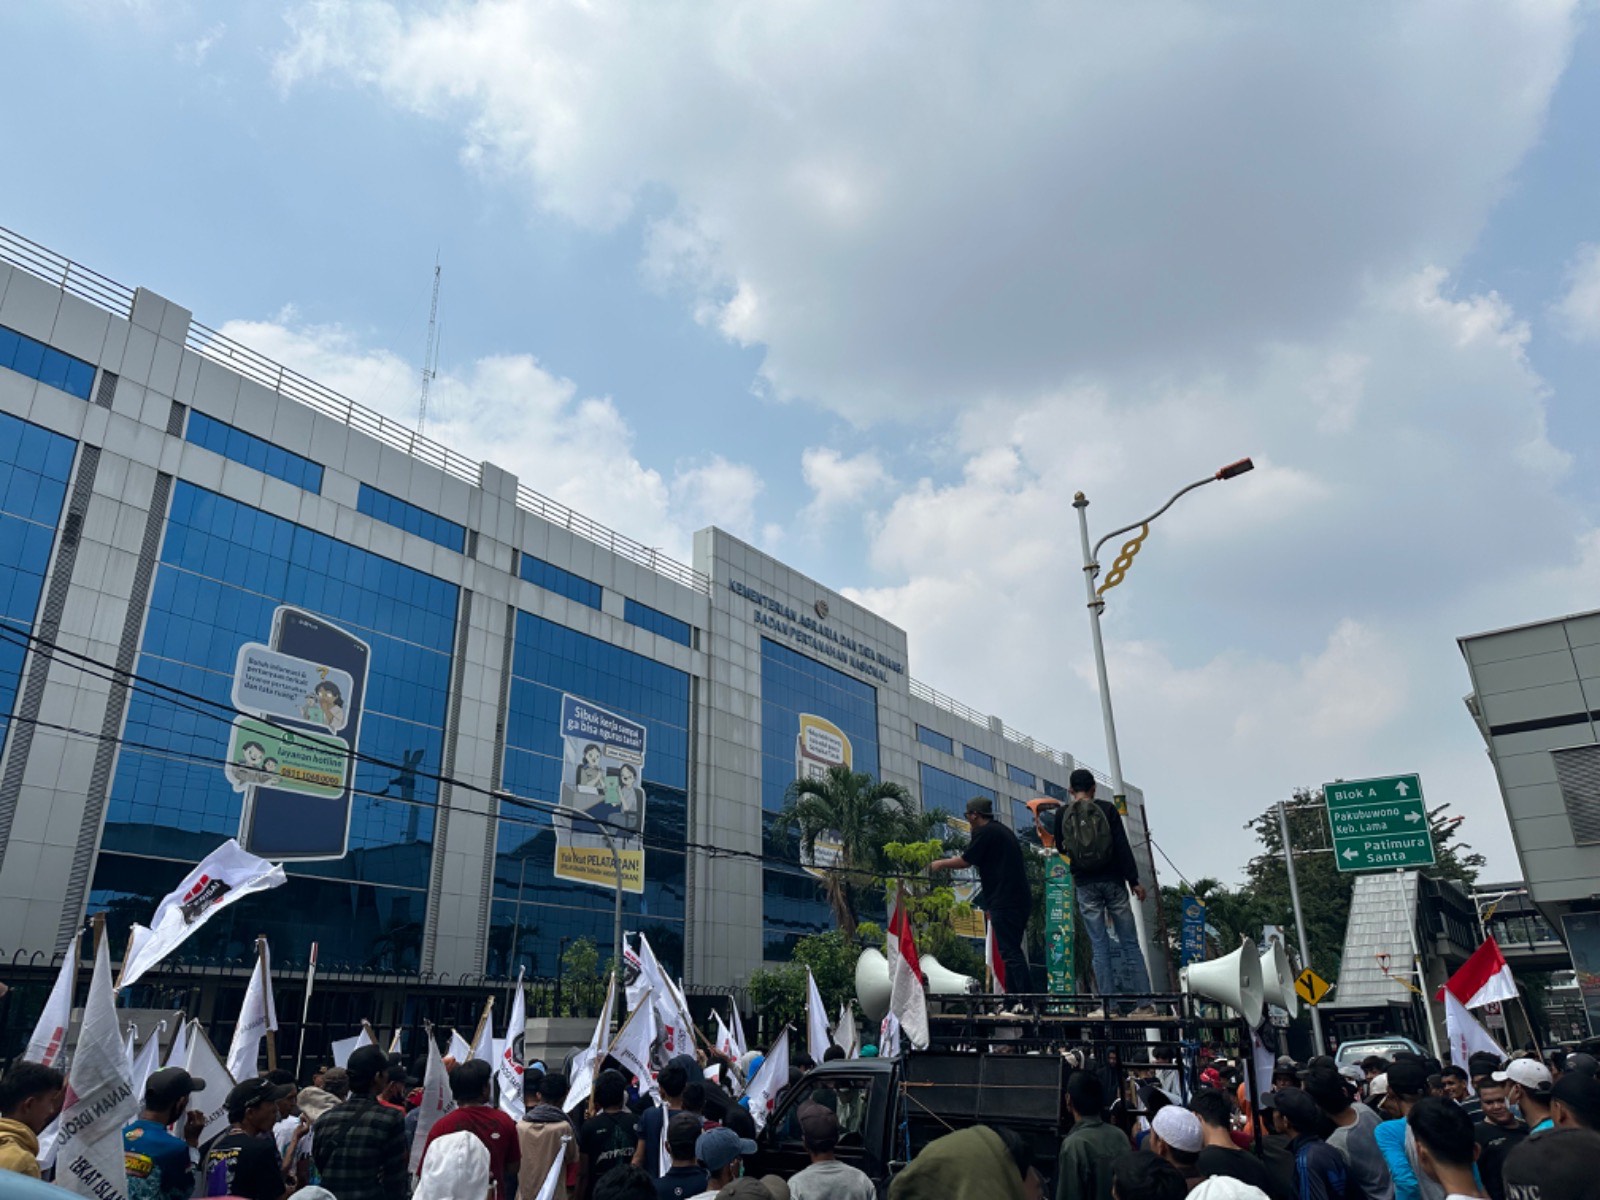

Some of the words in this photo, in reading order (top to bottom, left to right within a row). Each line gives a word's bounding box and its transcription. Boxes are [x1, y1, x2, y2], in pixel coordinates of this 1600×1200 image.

[729, 578, 797, 621] KEMENTERIAN
[798, 615, 838, 643] AGRARIA
[838, 634, 856, 652] DAN
[858, 643, 876, 661] TATA
[875, 652, 904, 675] RUANG
[754, 609, 787, 636] BADAN
[788, 625, 848, 664] PERTANAHAN
[850, 654, 888, 683] NASIONAL
[567, 719, 580, 731] ga
[580, 720, 598, 735] bisa
[574, 706, 599, 725] Sibuk
[599, 715, 618, 731] kerja
[618, 724, 640, 738] sampai
[277, 747, 312, 762] layanan
[312, 754, 342, 767] hotline
[1334, 788, 1364, 801] Blok
[1368, 788, 1377, 797] A
[1334, 807, 1400, 821] Pakubuwono
[1336, 823, 1358, 834] Keb.
[1360, 822, 1388, 832] Lama
[1364, 838, 1425, 850] Patimura
[587, 855, 639, 872] PELATAAN!
[1366, 851, 1406, 863] Santa
[1063, 889, 1072, 993] GEMAPATAS
